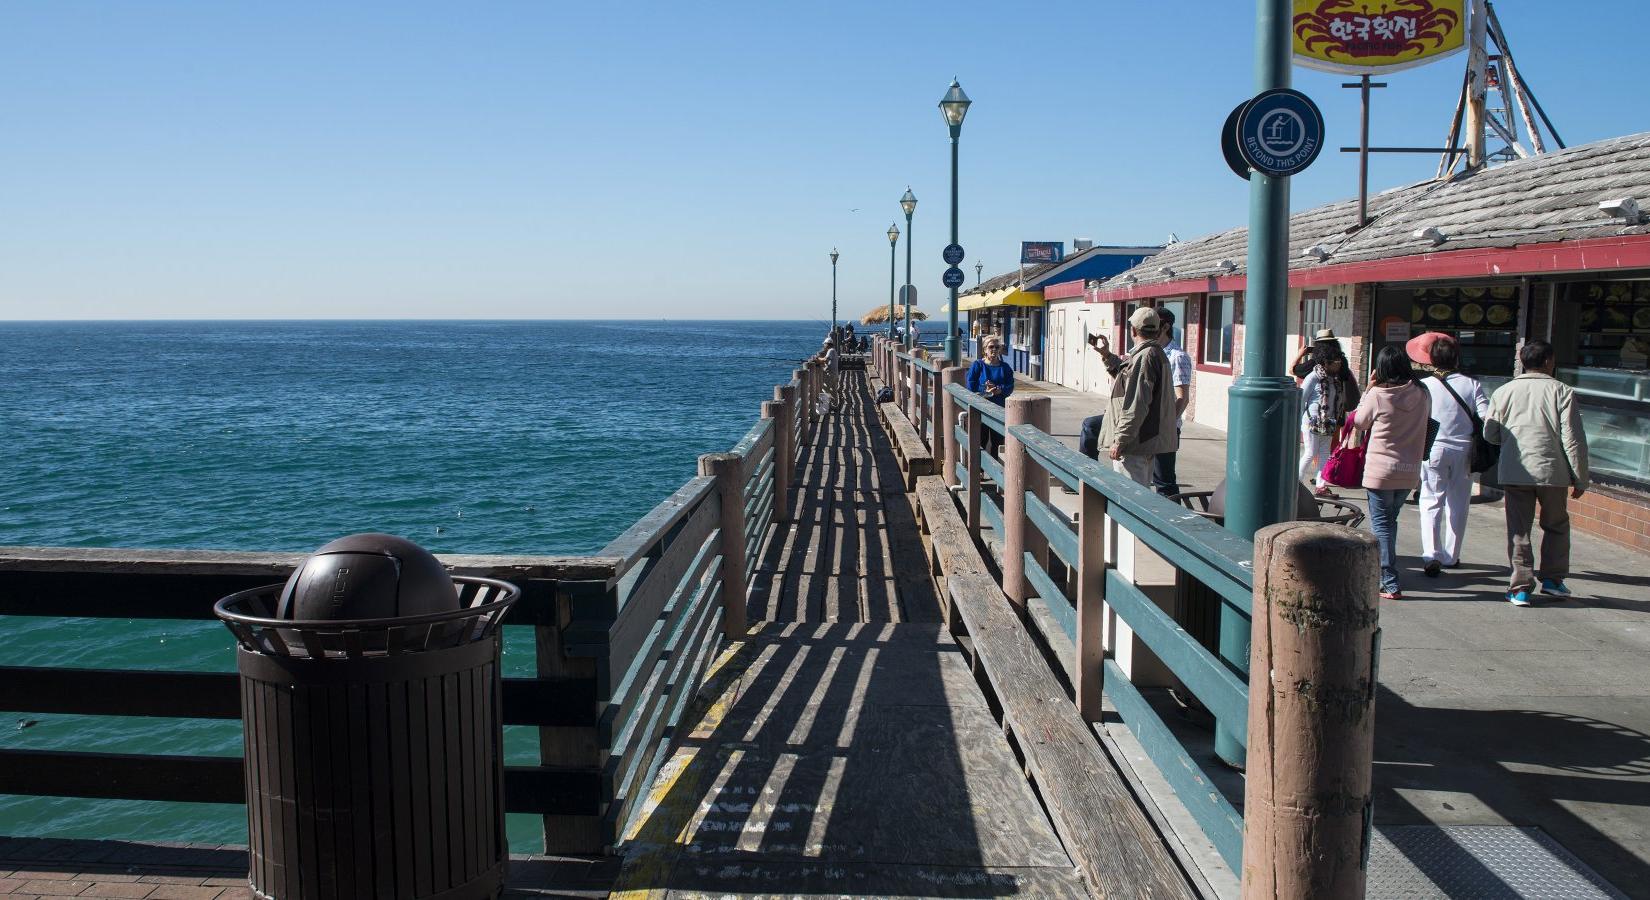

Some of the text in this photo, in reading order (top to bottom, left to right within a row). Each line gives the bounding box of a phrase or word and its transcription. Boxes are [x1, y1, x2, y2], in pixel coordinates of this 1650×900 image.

[1329, 16, 1417, 40] 한국횟집
[1247, 136, 1315, 168] BEYOND THIS POINT
[1333, 295, 1348, 310] 131
